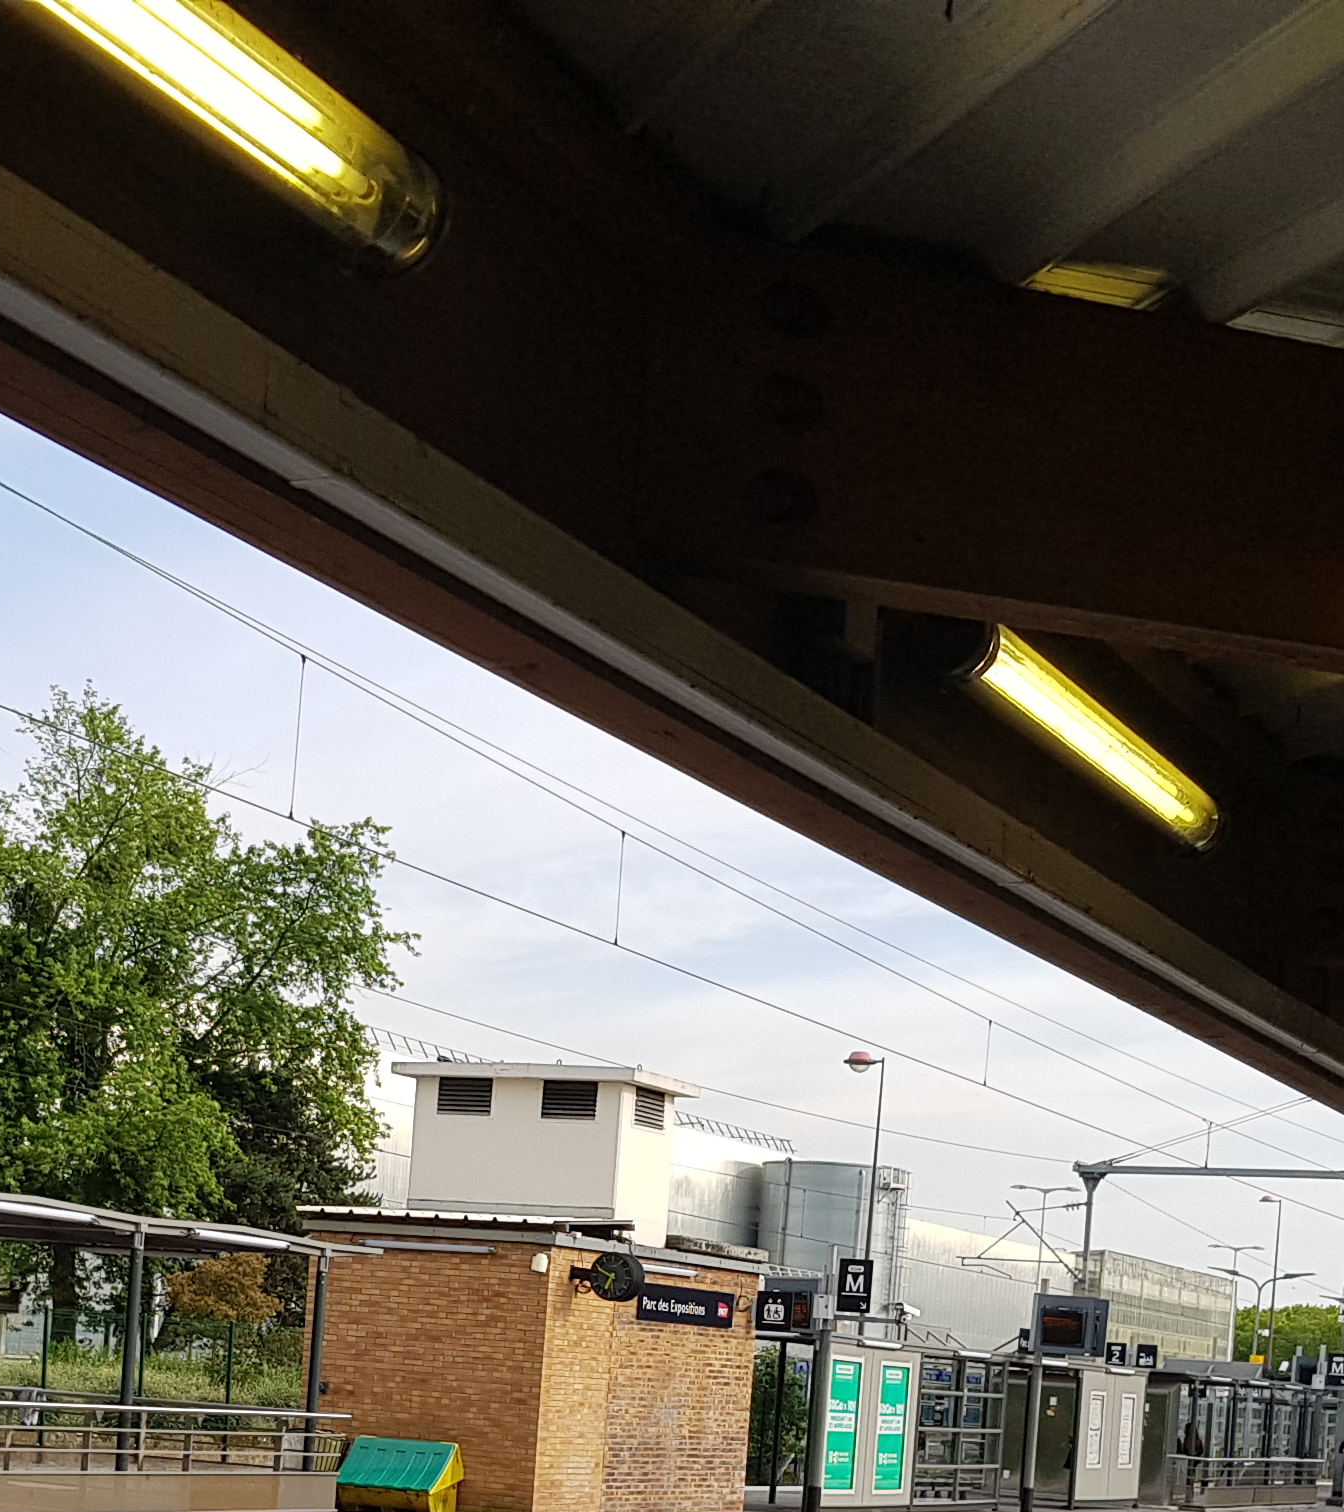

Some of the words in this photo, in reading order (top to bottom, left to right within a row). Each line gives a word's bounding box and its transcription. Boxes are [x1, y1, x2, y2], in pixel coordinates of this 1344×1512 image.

[845, 1273, 865, 1293] M
[642, 1296, 657, 1311] Parc
[657, 1298, 669, 1312] des
[670, 1299, 706, 1316] Expositions
[1111, 1350, 1120, 1362] 2
[1331, 1362, 1344, 1374] M
